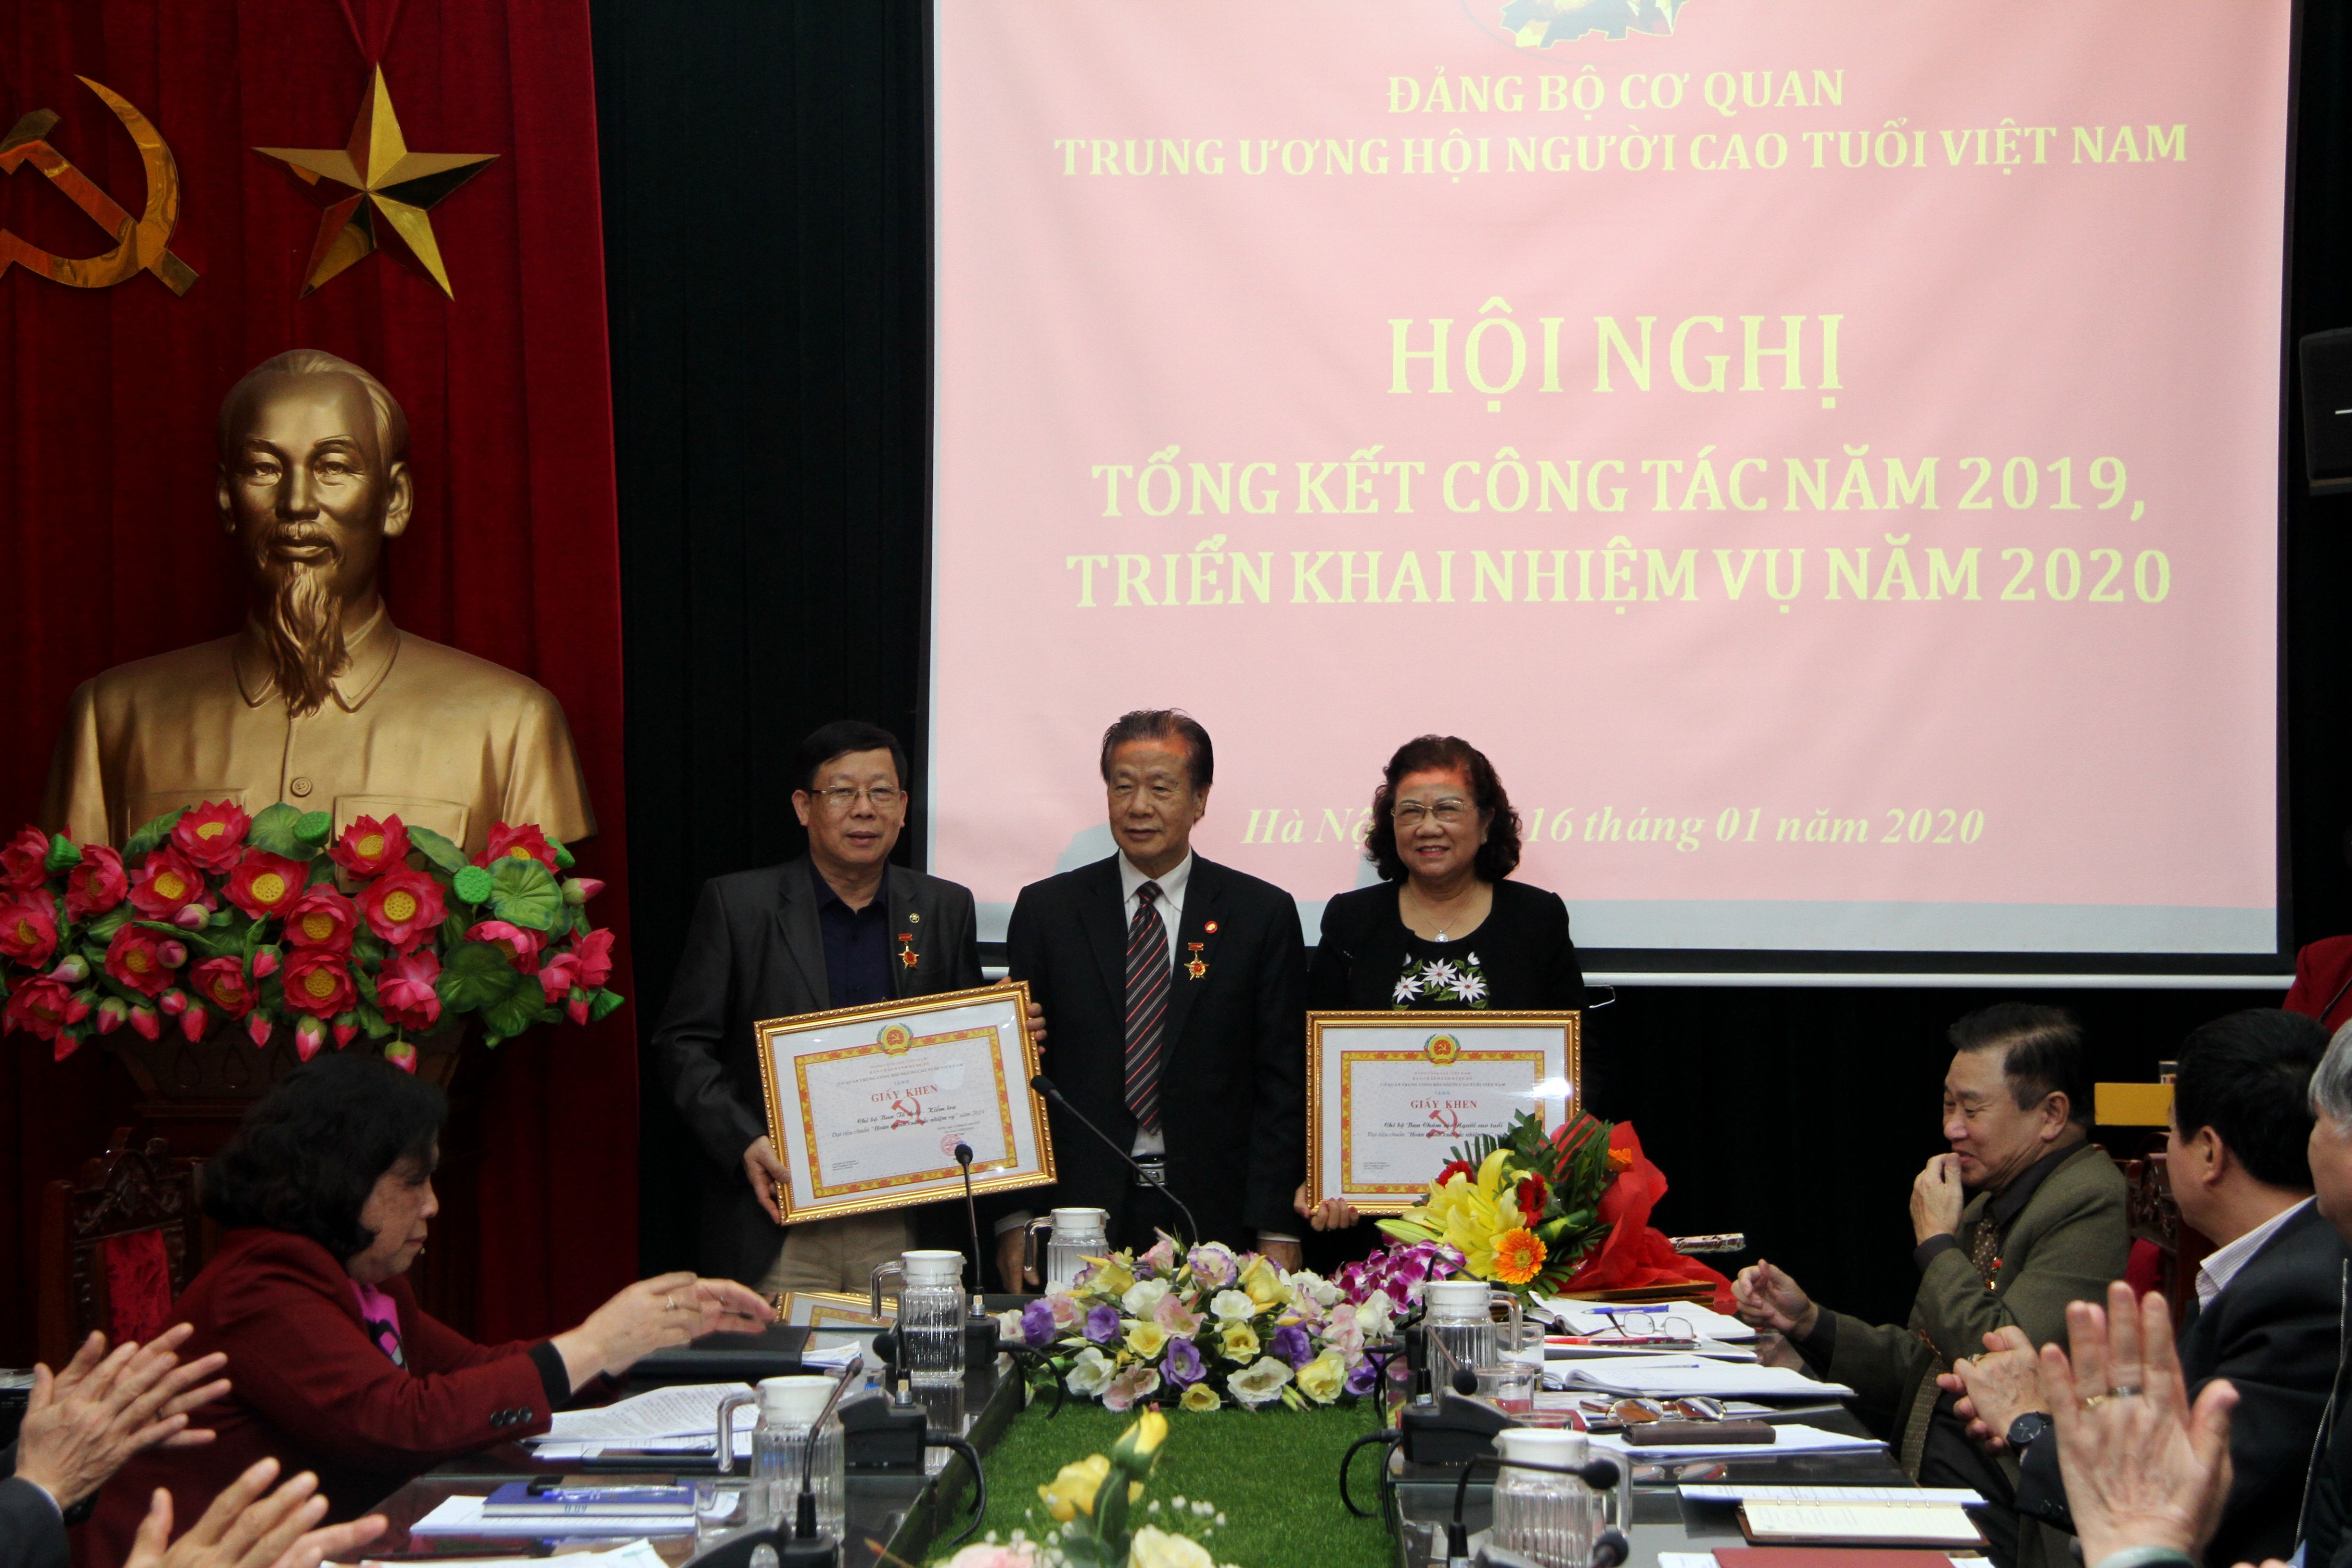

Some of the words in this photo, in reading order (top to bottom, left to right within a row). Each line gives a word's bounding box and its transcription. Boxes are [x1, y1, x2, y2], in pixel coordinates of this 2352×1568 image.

[1387, 65, 1525, 113] ĐẢNG
[1538, 64, 1606, 121] BỘ
[1620, 72, 1691, 111] CƠ
[1704, 69, 1844, 117] QUAN
[1054, 138, 1226, 176] TRUNG
[1239, 138, 1390, 175] ƯƠNG
[1402, 127, 1490, 184] HỘI
[1506, 124, 1676, 172] NGƯỜI
[1689, 132, 1789, 171] CAO
[1802, 117, 1927, 169] TUỔI
[1939, 117, 2058, 175] VIỆT
[2071, 123, 2188, 164] NAM
[1387, 294, 1566, 413] HỘI
[1593, 314, 1844, 410] NGHỊ
[1091, 444, 1280, 517] TỔNG
[1295, 444, 1426, 514] KẾT
[1442, 446, 1629, 513] CÔNG
[1640, 444, 1768, 512] TÁC
[1783, 444, 1940, 512] NĂM
[1957, 456, 2145, 522] 2019,
[1065, 533, 1274, 608] TRIỂN
[1290, 549, 1456, 604] KHAI
[1471, 534, 1700, 615] NHIỆM
[1712, 547, 1806, 614] VỤ
[1824, 532, 1983, 601] NĂM
[2000, 547, 2171, 603] 2020
[1240, 808, 1304, 844] Hà
[1313, 806, 1375, 851] Nộ
[1527, 807, 1574, 842] 16
[1583, 806, 1704, 851] tháng
[1716, 807, 1762, 842] 01
[1776, 809, 1869, 843] năm
[1881, 807, 1986, 844] 2020
[871, 1088, 900, 1103] GIẤY
[906, 1084, 938, 1097] KHEN
[1411, 1096, 1439, 1109] GIẤY
[1445, 1100, 1477, 1108] KHEN
